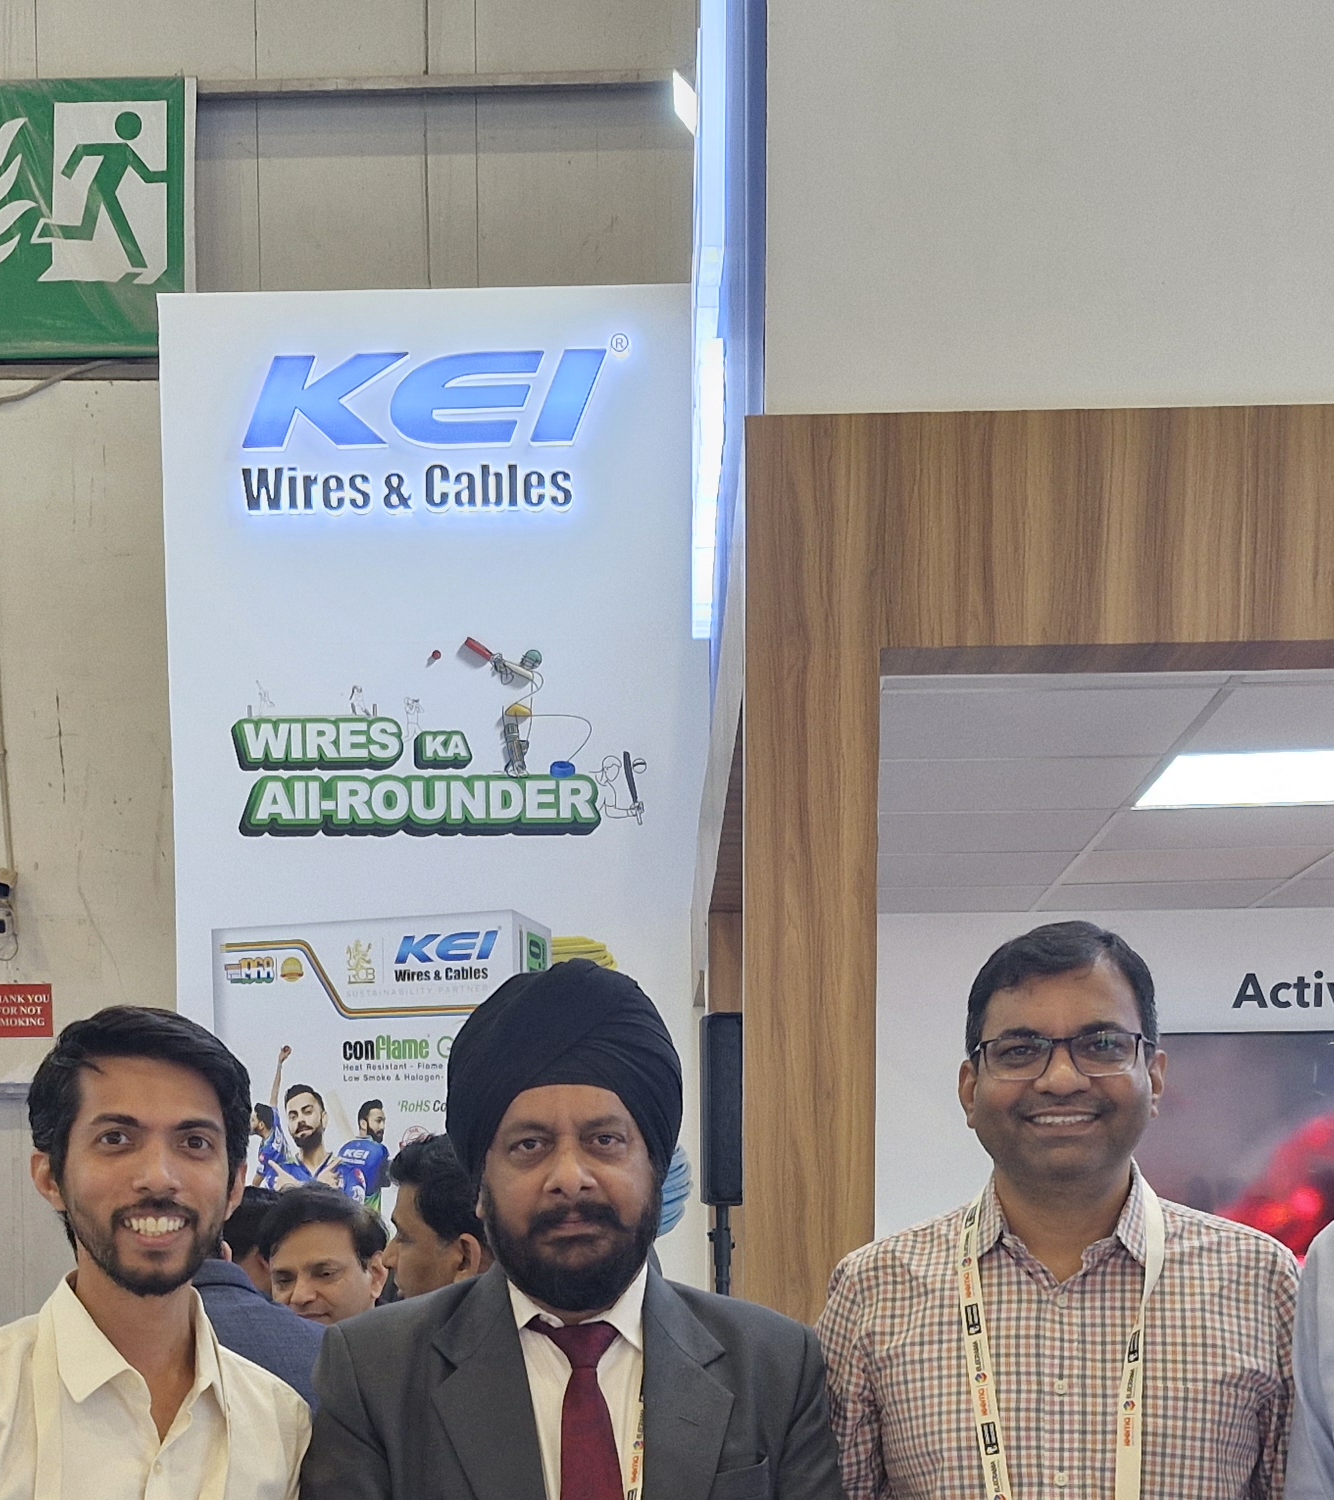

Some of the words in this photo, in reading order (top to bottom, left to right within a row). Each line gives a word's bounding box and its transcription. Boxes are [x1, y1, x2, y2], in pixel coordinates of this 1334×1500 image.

[242, 348, 607, 451] KEI
[242, 466, 370, 513] Wires
[382, 472, 412, 512] &
[425, 463, 573, 510] Cables
[240, 720, 404, 763] WIRES
[423, 733, 471, 762] KA
[394, 930, 500, 965] KEI
[348, 967, 376, 983] RCB
[394, 968, 431, 983] Wires
[433, 969, 443, 982] &
[445, 966, 489, 982] Cables
[438, 984, 489, 994] PARTNER
[27, 993, 50, 1003] YOU
[20, 1006, 42, 1015] NOT
[366, 1062, 407, 1071] Resistant
[342, 1149, 370, 1160] KEI
